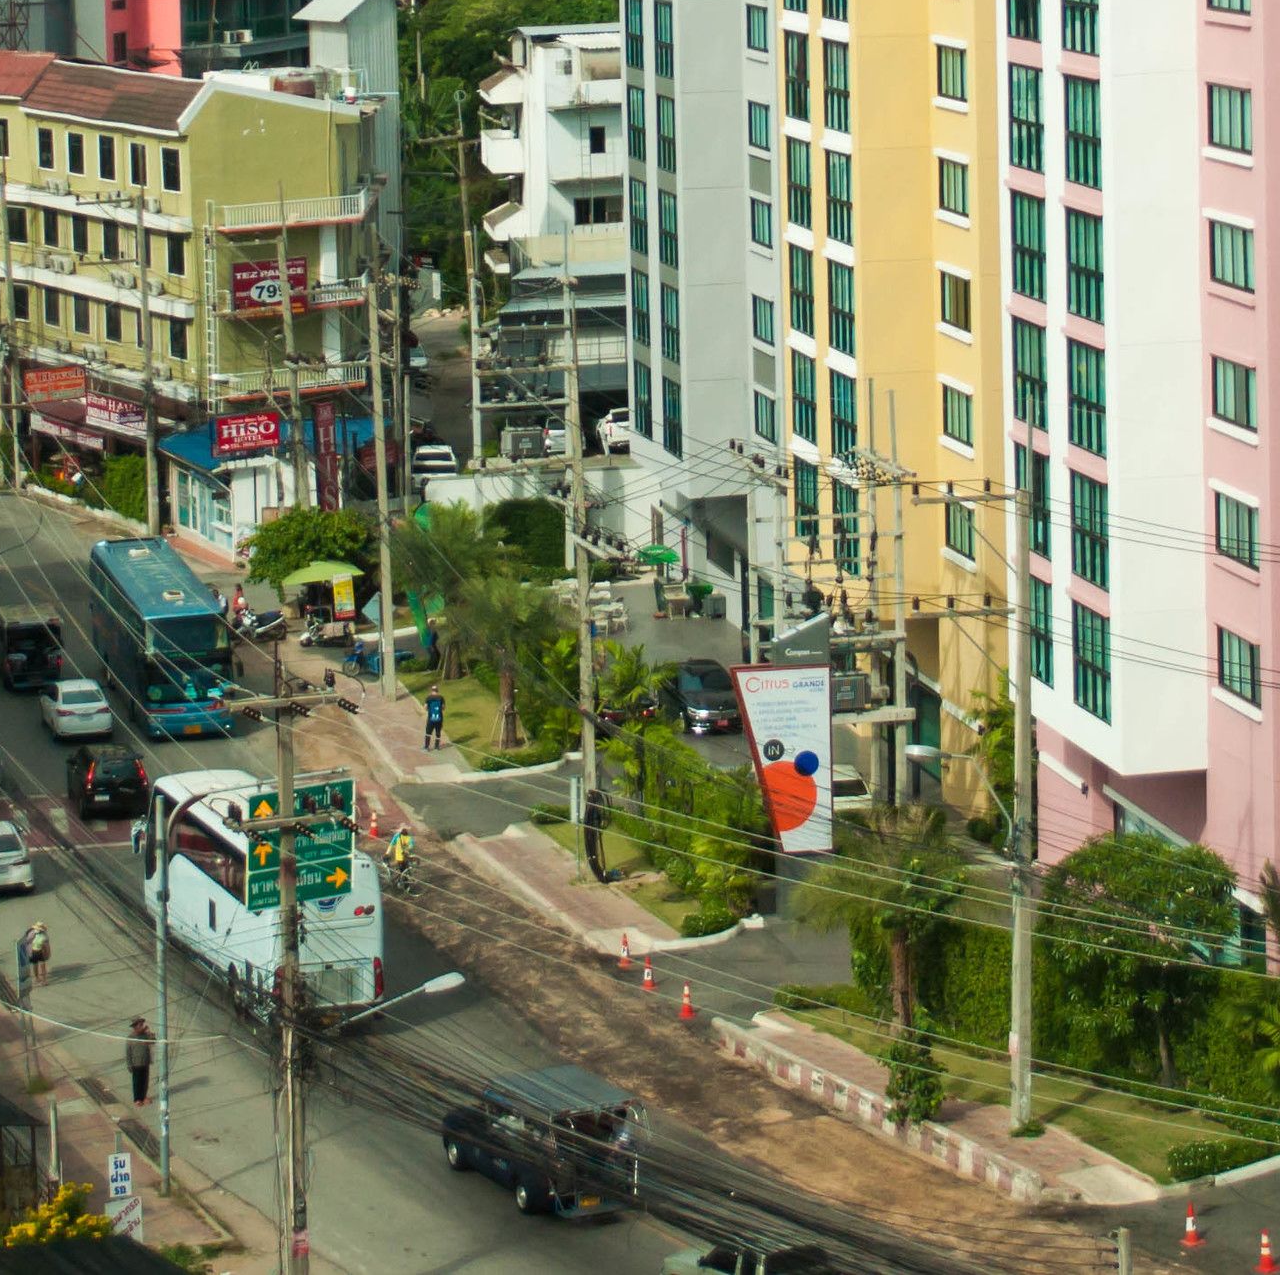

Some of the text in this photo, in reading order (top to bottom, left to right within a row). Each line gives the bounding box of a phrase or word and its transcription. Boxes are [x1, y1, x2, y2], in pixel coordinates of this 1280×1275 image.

[259, 267, 304, 278] PALCE
[221, 420, 276, 438] HISO
[234, 434, 262, 443] HOTEL
[319, 425, 337, 512] HIS
[792, 679, 825, 688] GRANDE
[768, 747, 780, 756] IN
[113, 1157, 126, 1170] รับ
